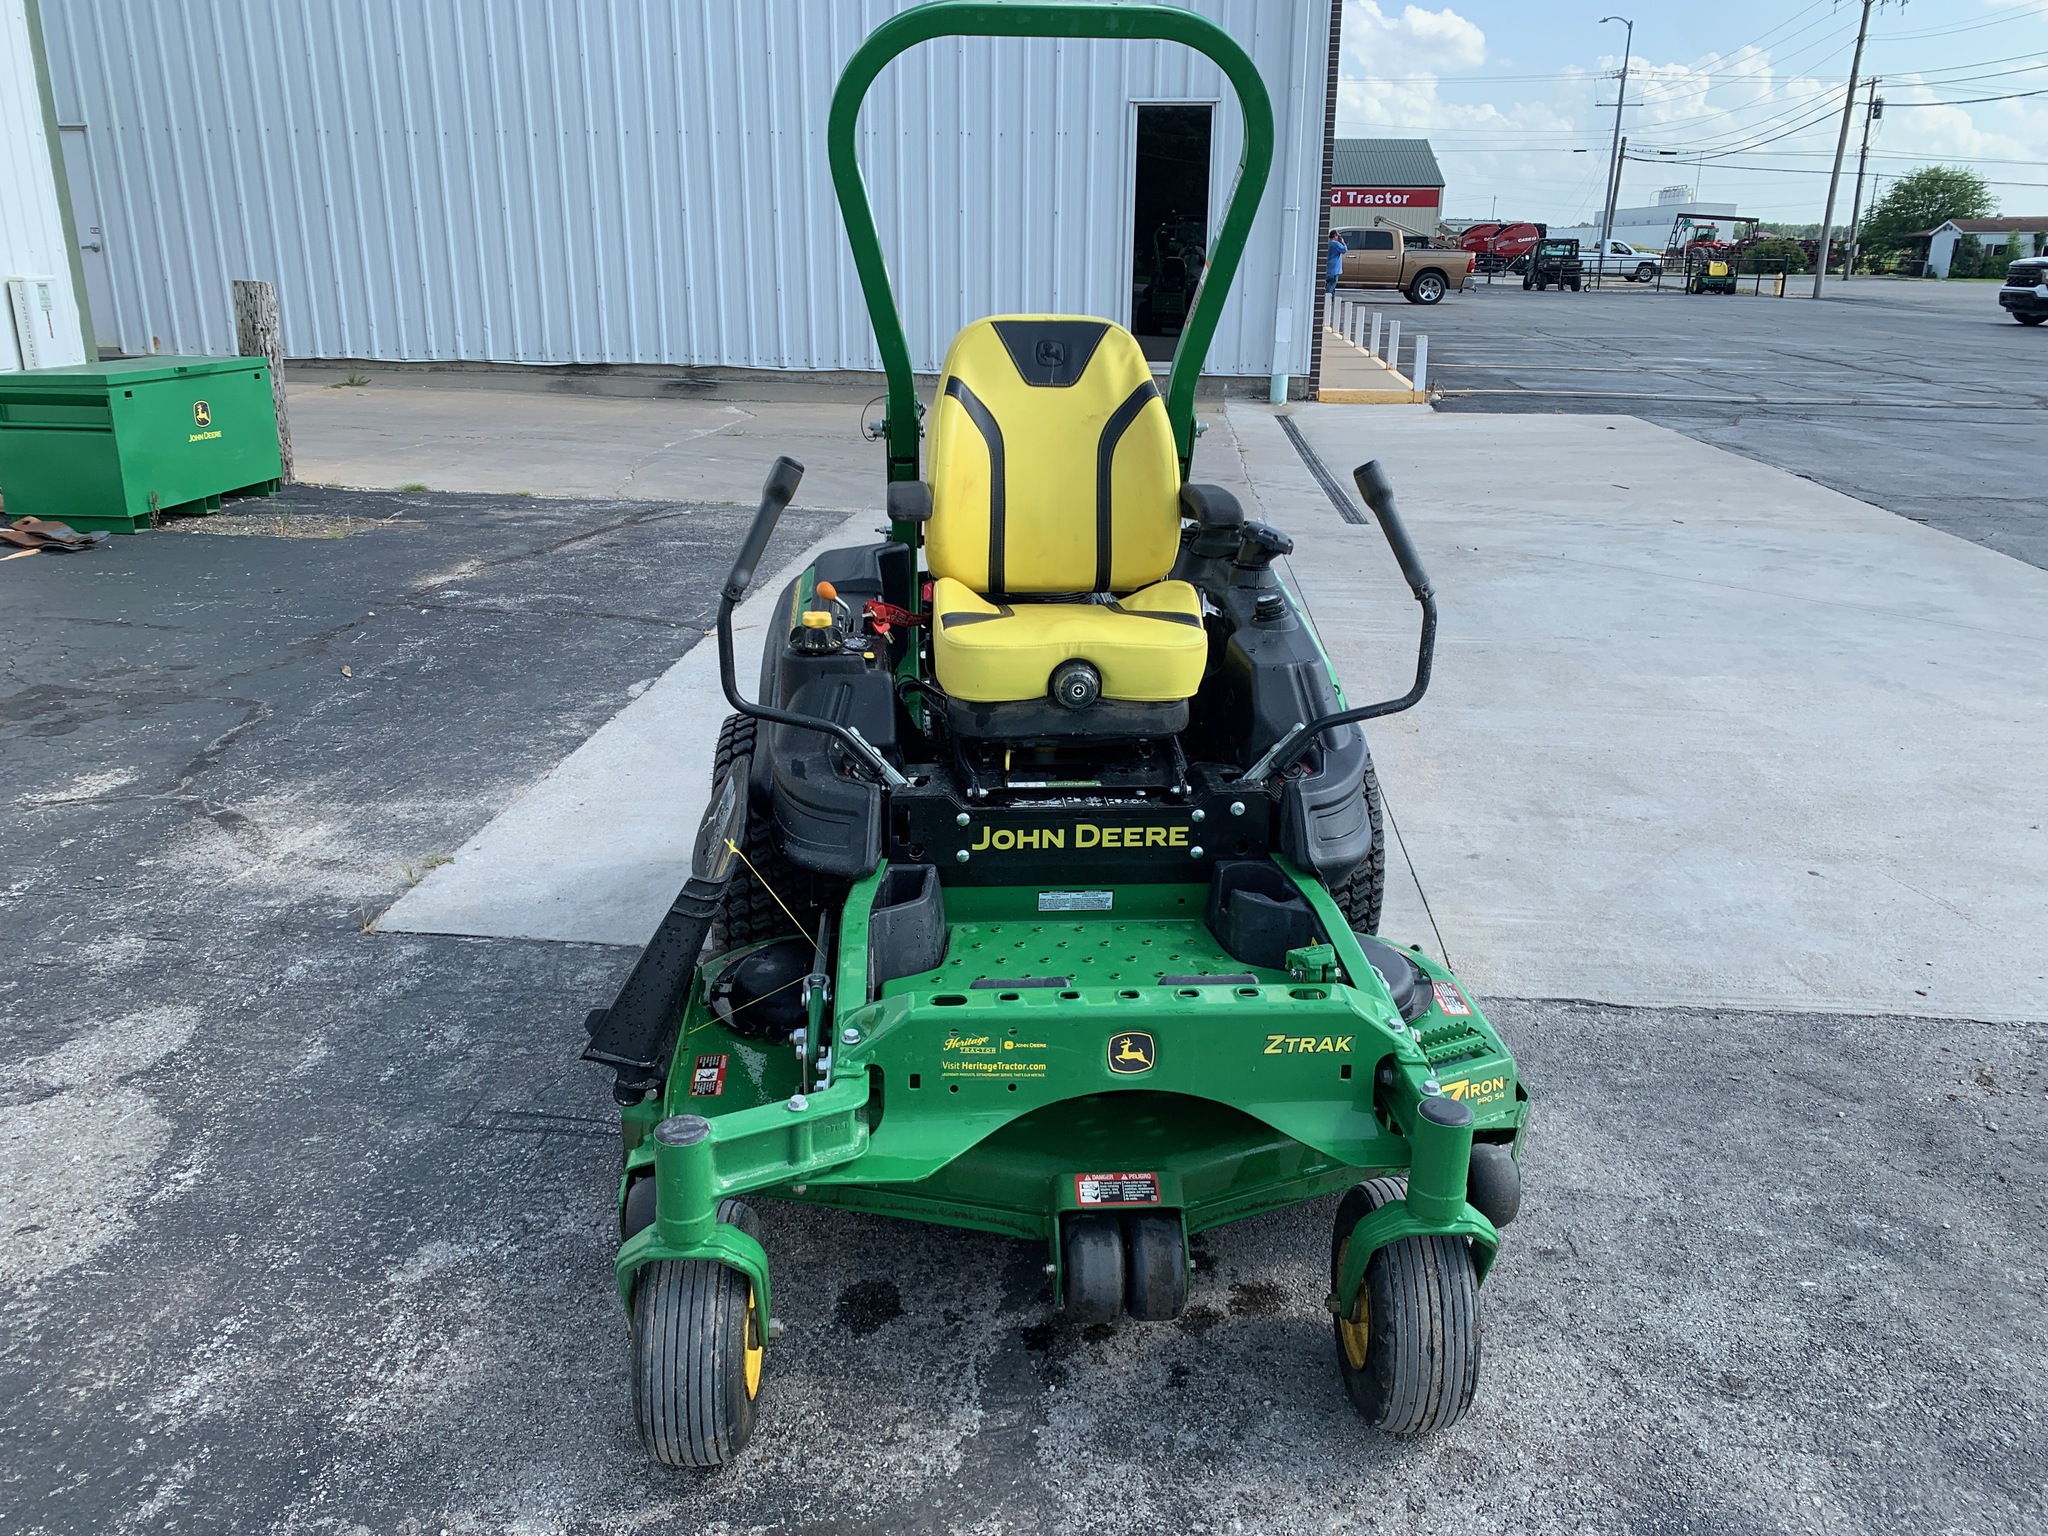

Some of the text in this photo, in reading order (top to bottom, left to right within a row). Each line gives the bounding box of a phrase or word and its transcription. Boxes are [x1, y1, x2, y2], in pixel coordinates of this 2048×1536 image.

[1346, 191, 1409, 204] Tractor
[189, 431, 222, 442] JOHN DEERE
[971, 824, 1189, 850] JOHN DEERE
[943, 1036, 990, 1051] Heritage
[1263, 1034, 1354, 1054] ZTRAK
[942, 1061, 1047, 1072] Visit HeritageTractor.com
[1477, 1092, 1505, 1105] PRO 54
